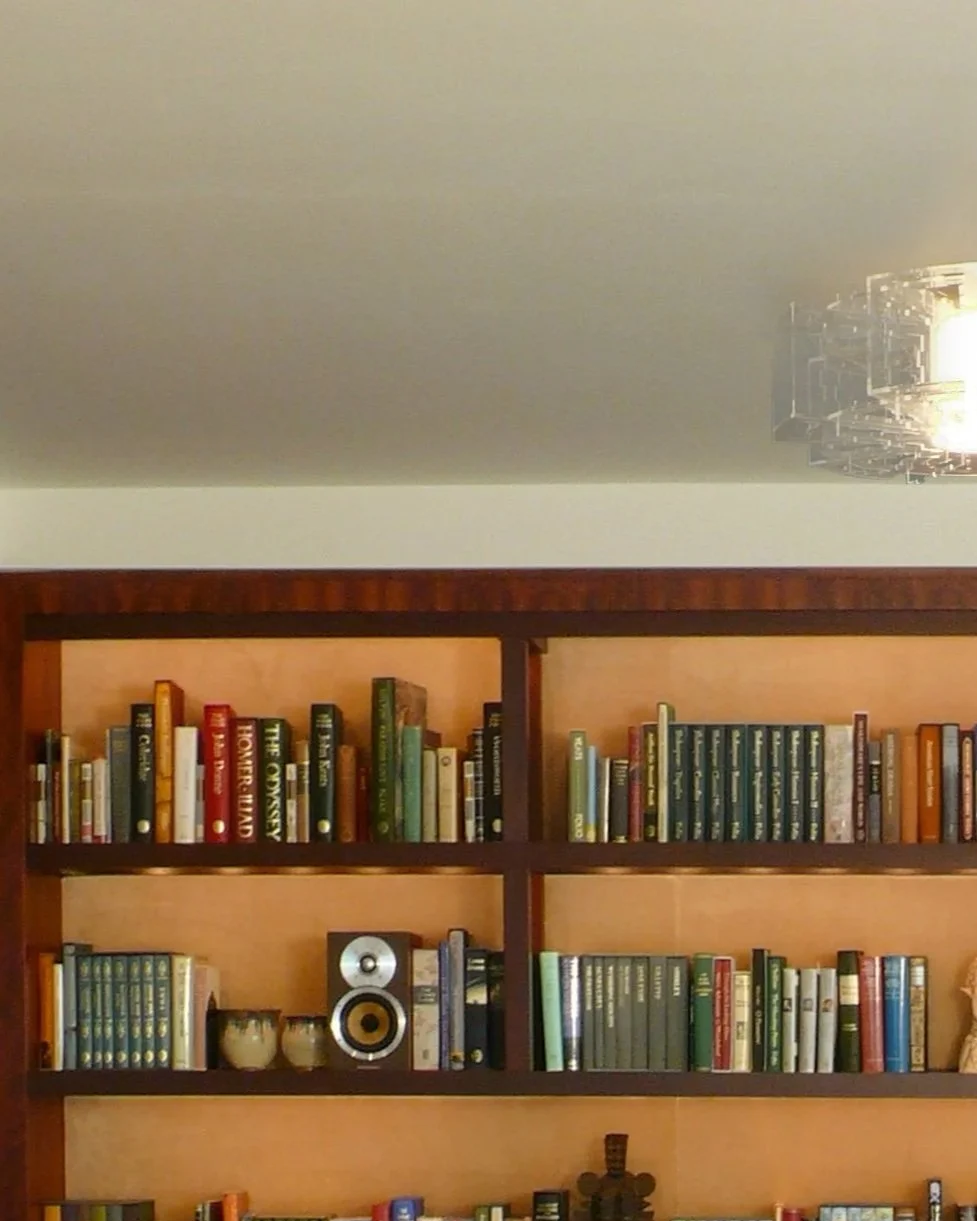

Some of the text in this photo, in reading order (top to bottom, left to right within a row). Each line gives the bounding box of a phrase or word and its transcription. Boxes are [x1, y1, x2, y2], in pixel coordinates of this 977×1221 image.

[213, 734, 226, 758] John
[318, 734, 331, 759] John
[574, 737, 583, 760] YEATS
[237, 725, 254, 839] HOMER ILIAD
[264, 724, 282, 842] THE ODYSSEY
[318, 760, 331, 788] Keats
